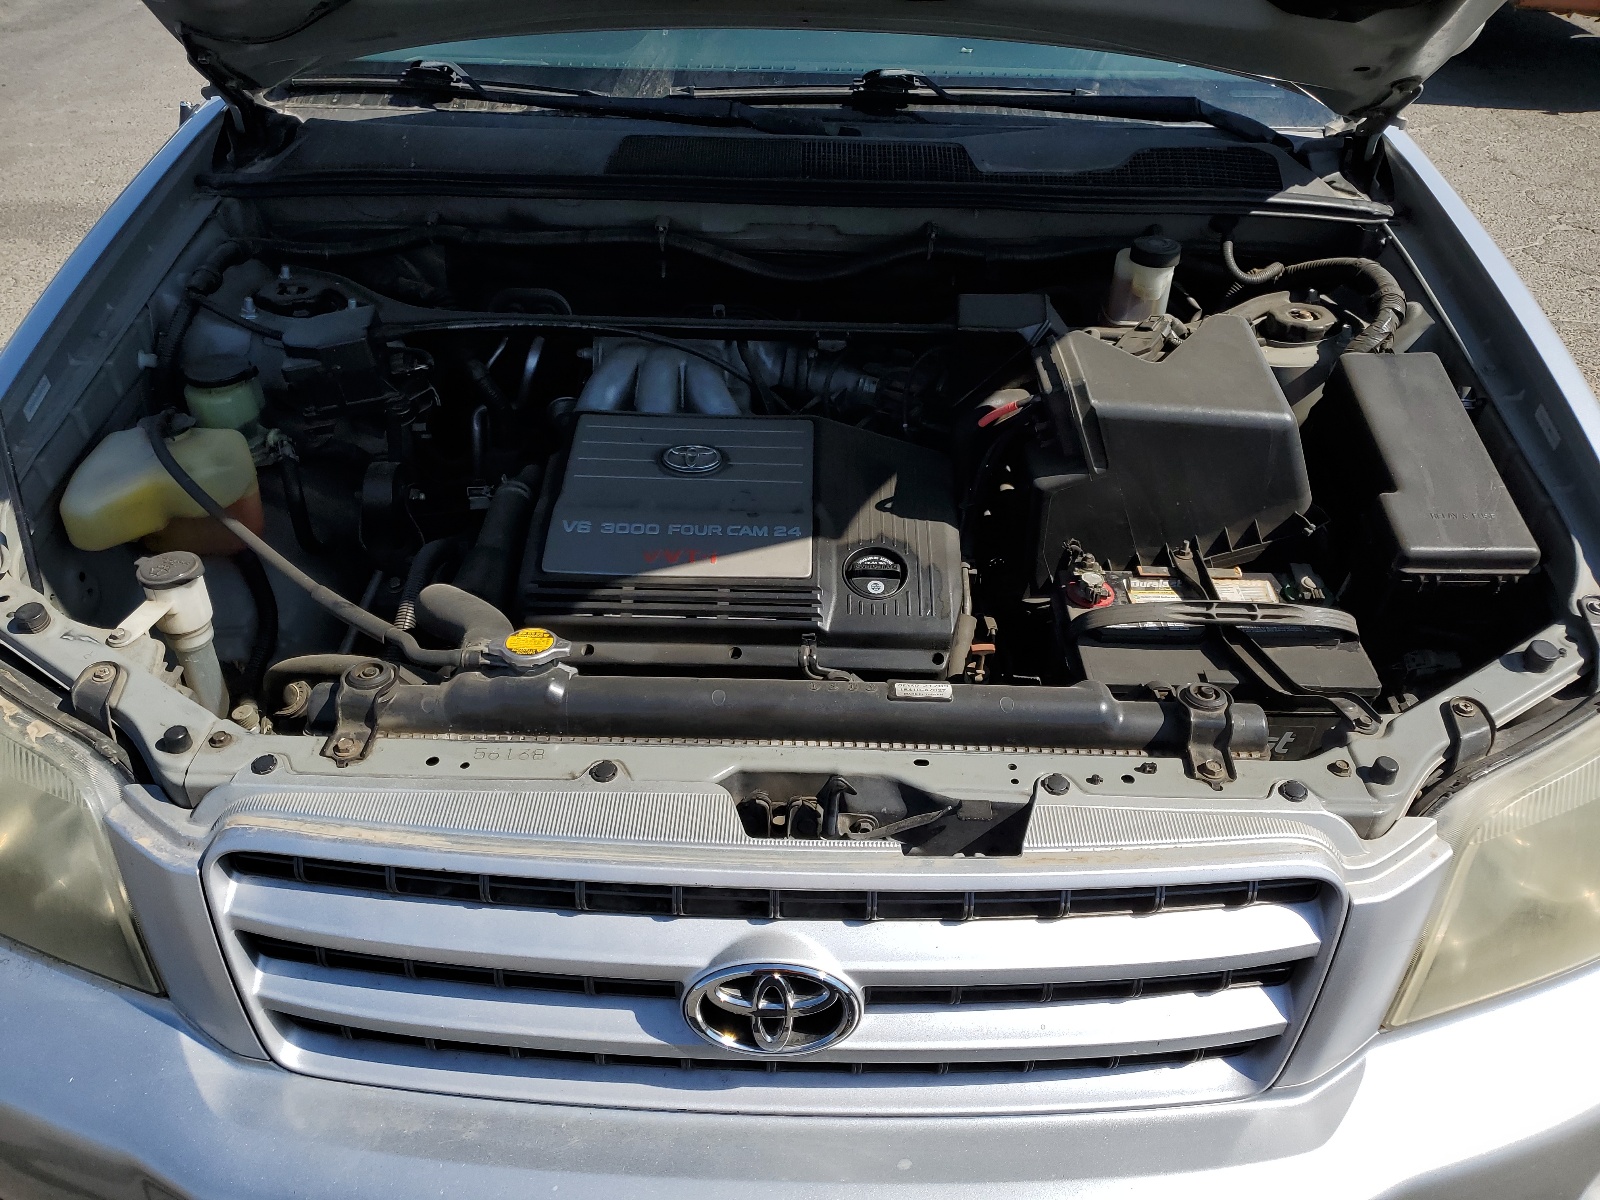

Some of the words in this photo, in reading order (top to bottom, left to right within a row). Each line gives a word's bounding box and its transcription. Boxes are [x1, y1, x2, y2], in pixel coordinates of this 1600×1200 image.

[562, 519, 592, 533] V6
[600, 522, 660, 535] 3000
[667, 523, 723, 536] FOUR
[726, 524, 769, 537] CAM
[773, 525, 802, 537] 24
[1130, 579, 1183, 589] Duralast
